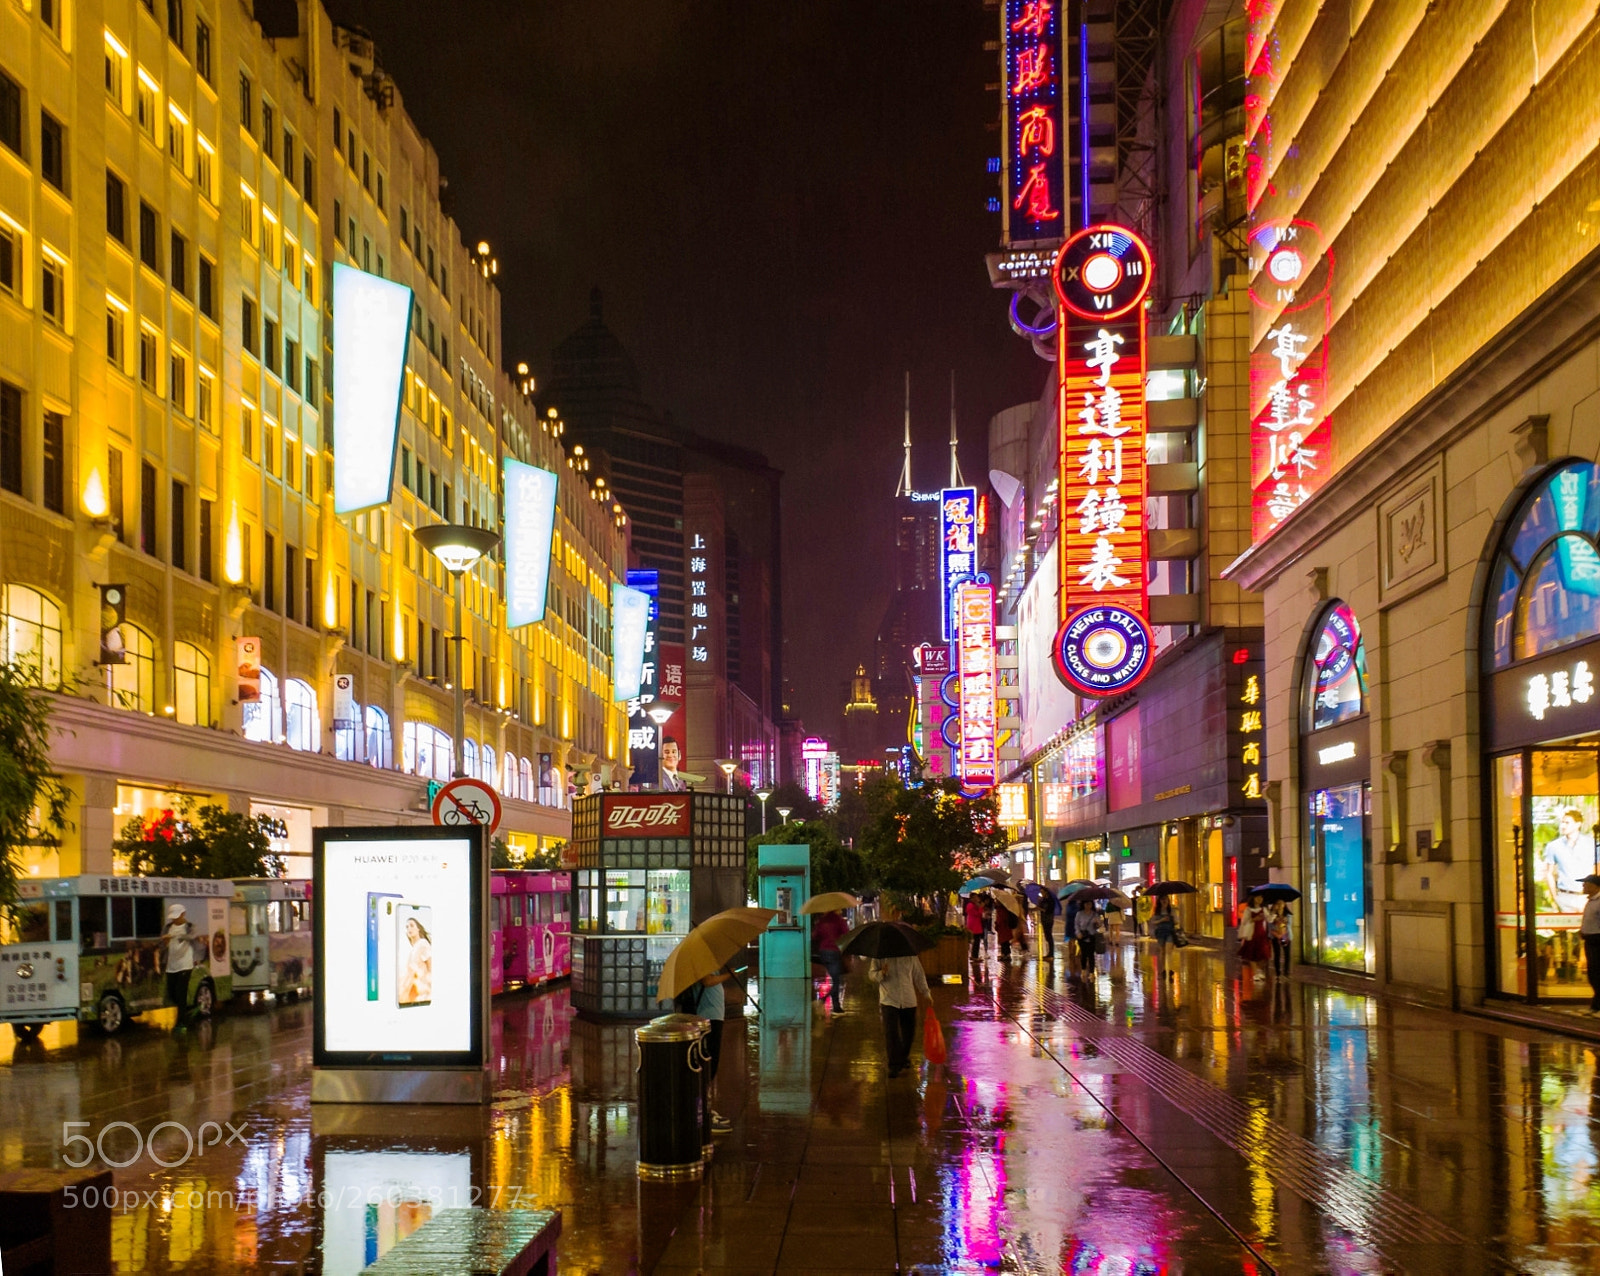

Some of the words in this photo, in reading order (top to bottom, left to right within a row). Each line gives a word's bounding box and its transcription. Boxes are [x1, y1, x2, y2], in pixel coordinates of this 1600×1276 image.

[998, 259, 1057, 270] COMMERC
[690, 534, 708, 662] 上海置地广场
[1069, 612, 1104, 639] HENG
[1109, 610, 1141, 638] DALI
[665, 663, 682, 684] 语
[1067, 644, 1090, 678] CLOCKS
[1090, 673, 1110, 683] AND
[1113, 644, 1143, 681] WATCHES
[608, 802, 687, 830] 可口可乐
[354, 855, 398, 864] HUAWEI
